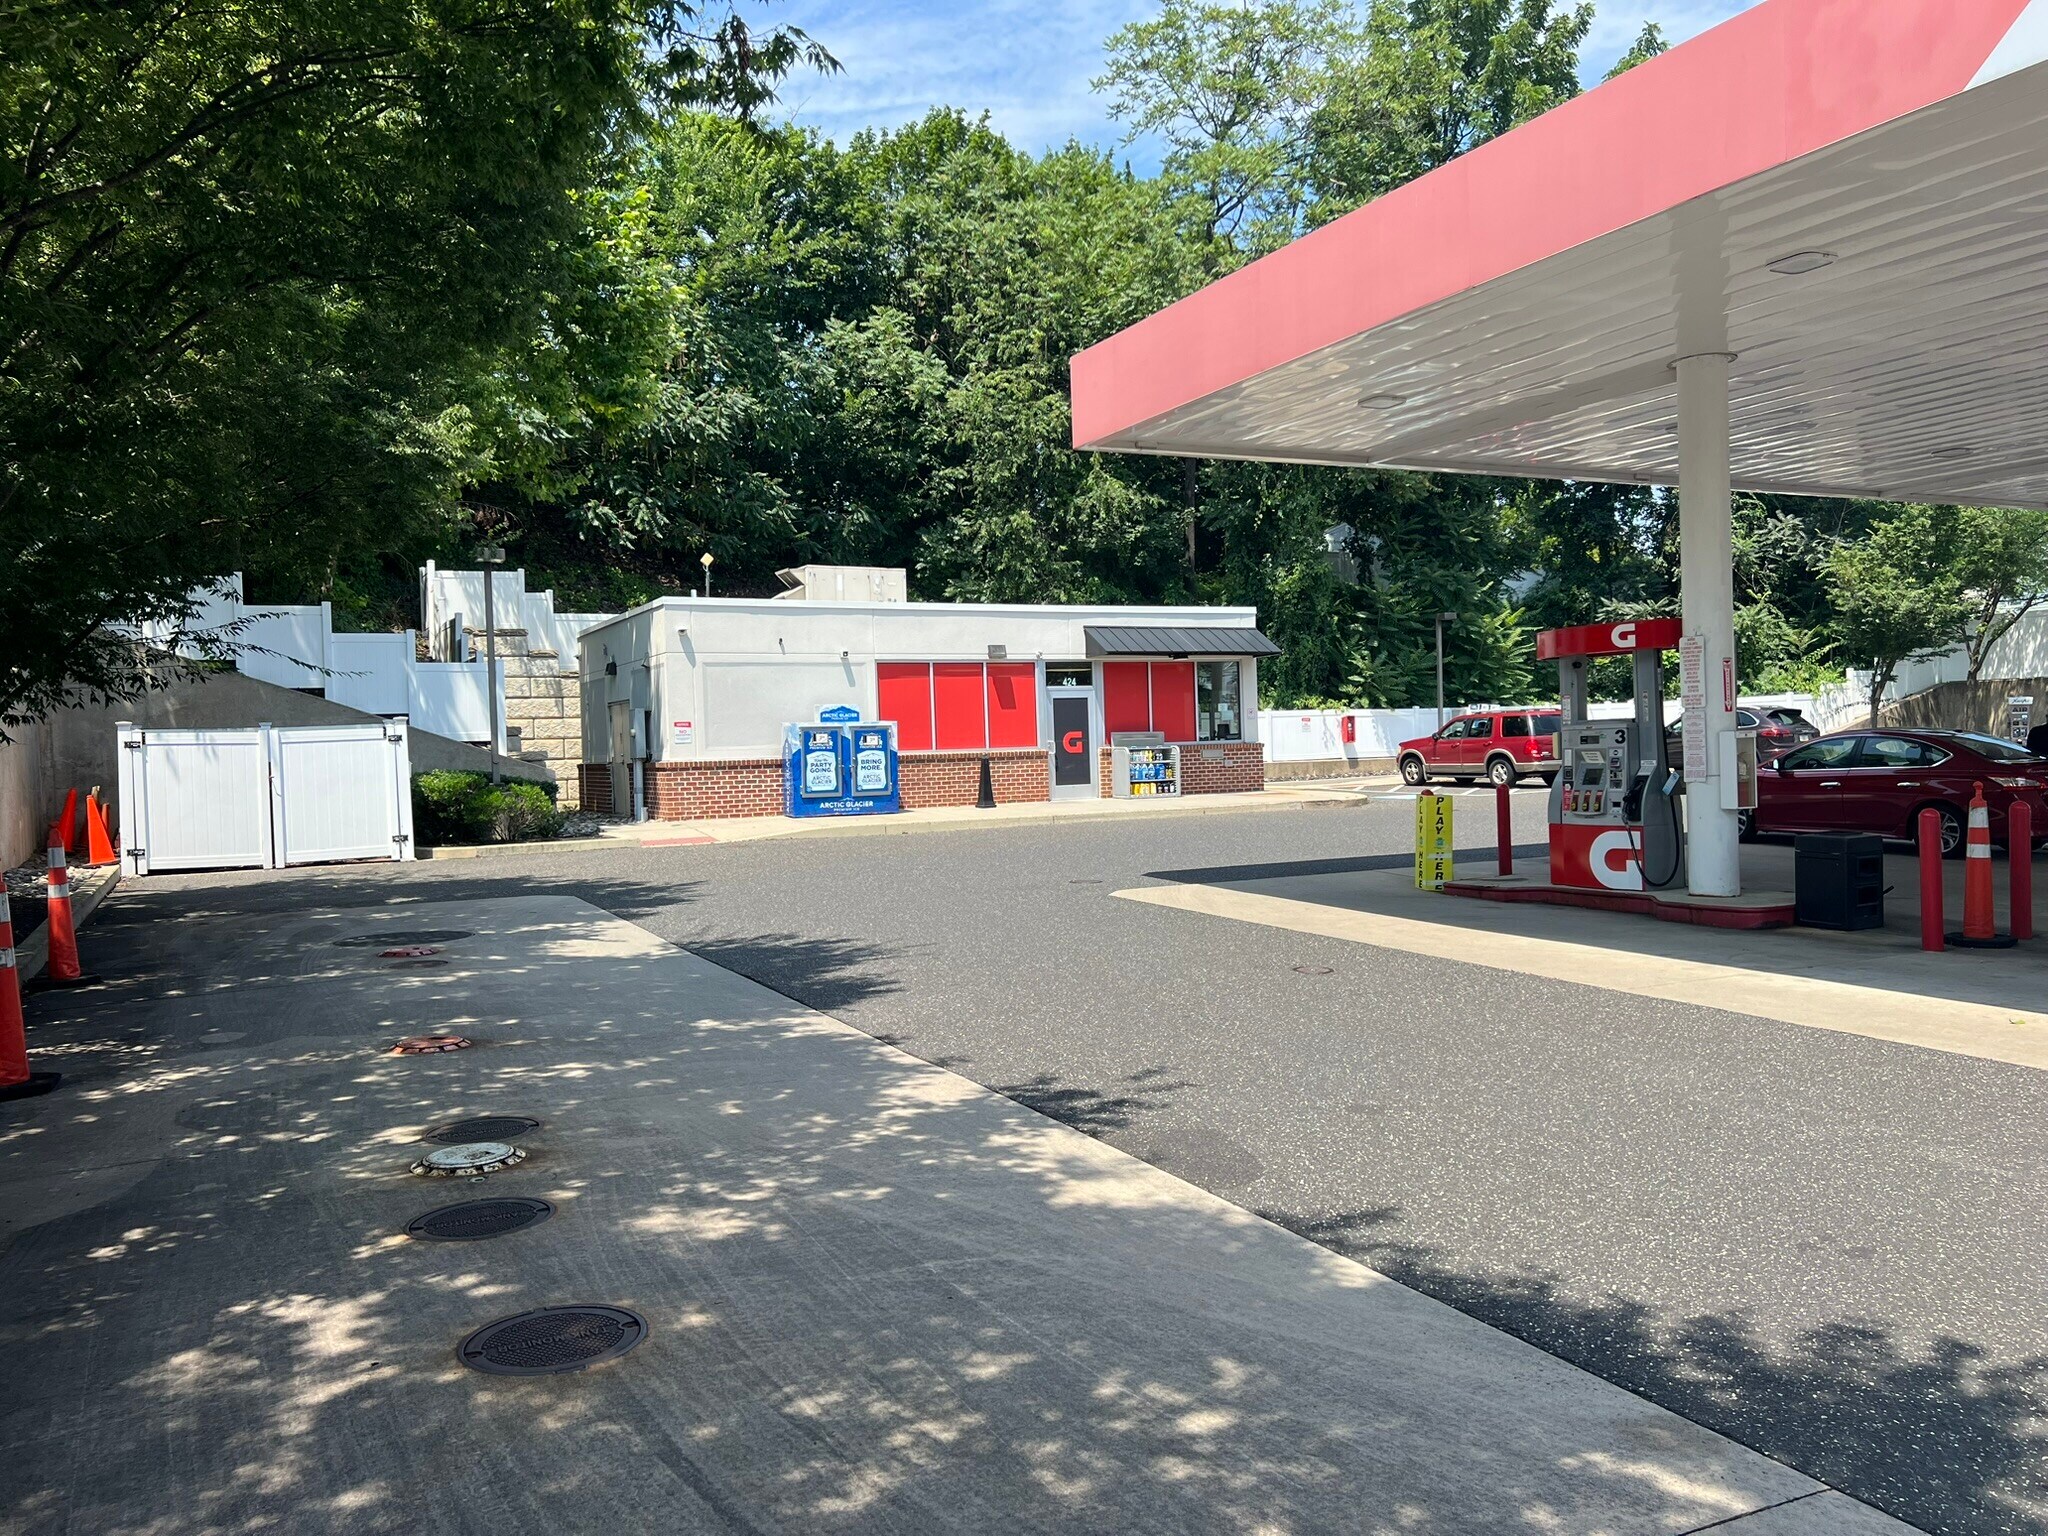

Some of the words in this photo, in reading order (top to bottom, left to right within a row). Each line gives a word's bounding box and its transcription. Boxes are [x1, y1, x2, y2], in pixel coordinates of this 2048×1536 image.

[1611, 623, 1636, 648] G
[1062, 677, 1077, 687] 424
[1062, 731, 1083, 754] G
[1614, 729, 1626, 745] 3
[1435, 797, 1444, 834] PLAY
[1589, 830, 1643, 890] G
[570, 1326, 608, 1339] TANK
[497, 1334, 567, 1352] MONITOR
